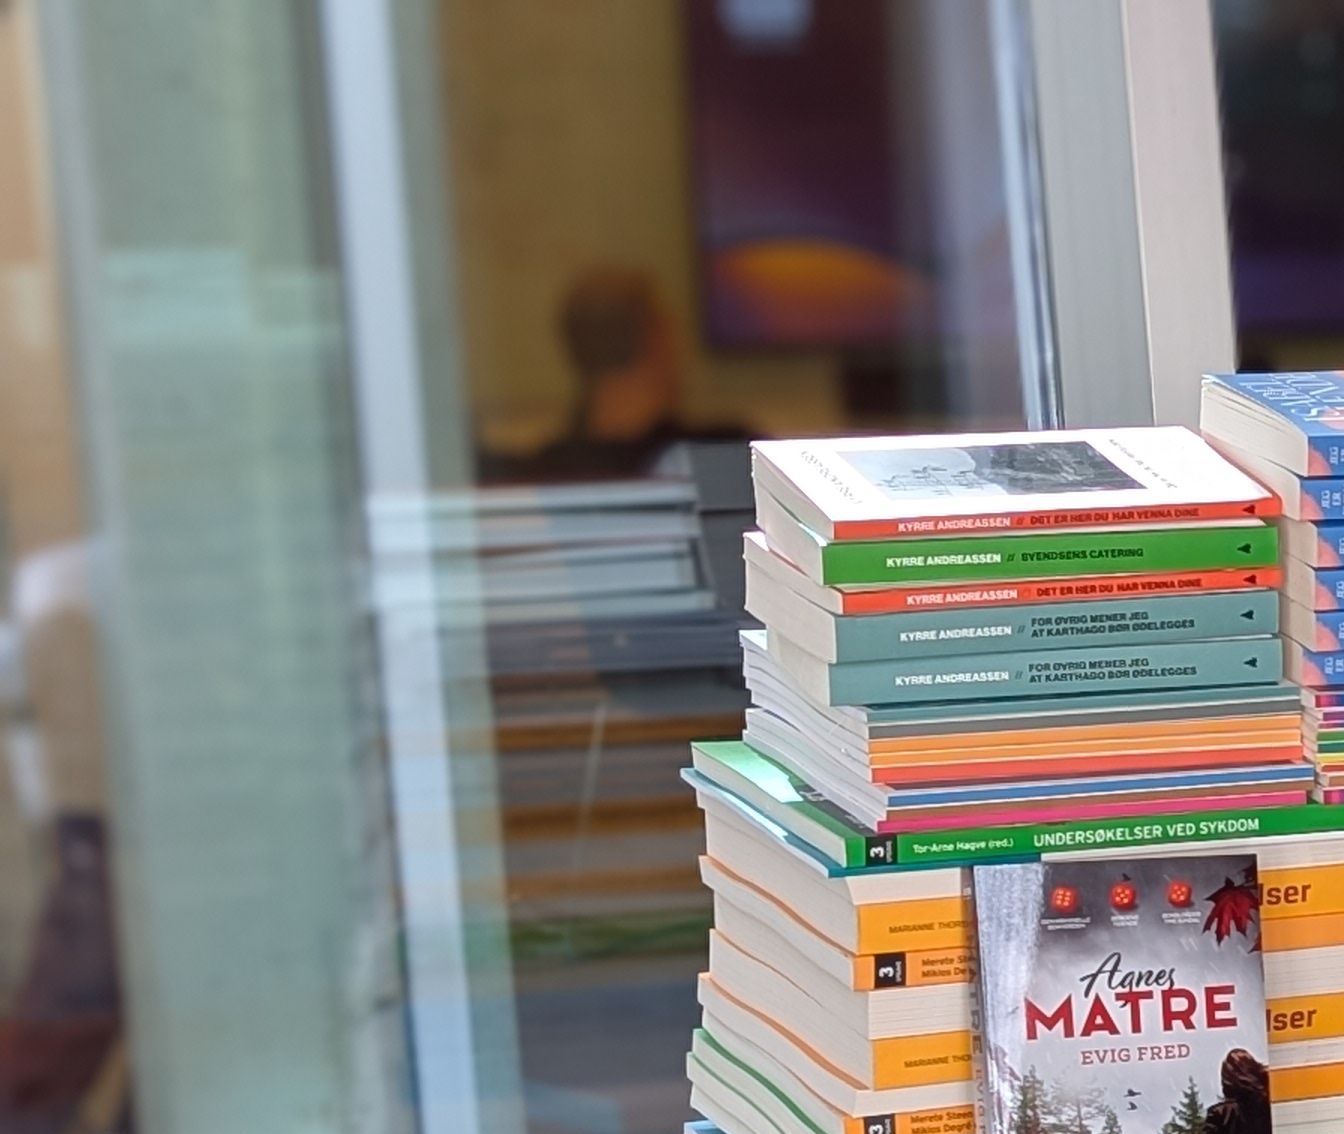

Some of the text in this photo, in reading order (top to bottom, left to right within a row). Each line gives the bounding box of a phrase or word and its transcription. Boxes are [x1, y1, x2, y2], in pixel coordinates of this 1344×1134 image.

[898, 517, 1010, 532] KYRRE ANDREASSEN
[886, 554, 1001, 567] KYRRE ANDREASSEN
[1090, 548, 1143, 559] CATERING
[907, 590, 1017, 605] KYRRE ANDREASSEN
[1031, 617, 1053, 626] FOR
[1056, 615, 1087, 625] ØVRIG
[1129, 612, 1148, 620] JEG
[900, 626, 1011, 641] KYRRE ANDREASSEN
[1047, 624, 1105, 636] KARTHAGO
[1029, 663, 1051, 671] FOR
[1128, 658, 1149, 667] JEG
[895, 671, 1009, 686] KYRRE ANDREASSEN
[1034, 819, 1259, 847] UNDERSØKELSER VED SYKDOM
[1080, 951, 1176, 1008] Agnes
[1024, 985, 1237, 1041] MATRE
[1081, 1044, 1190, 1065] EVIG FRED
